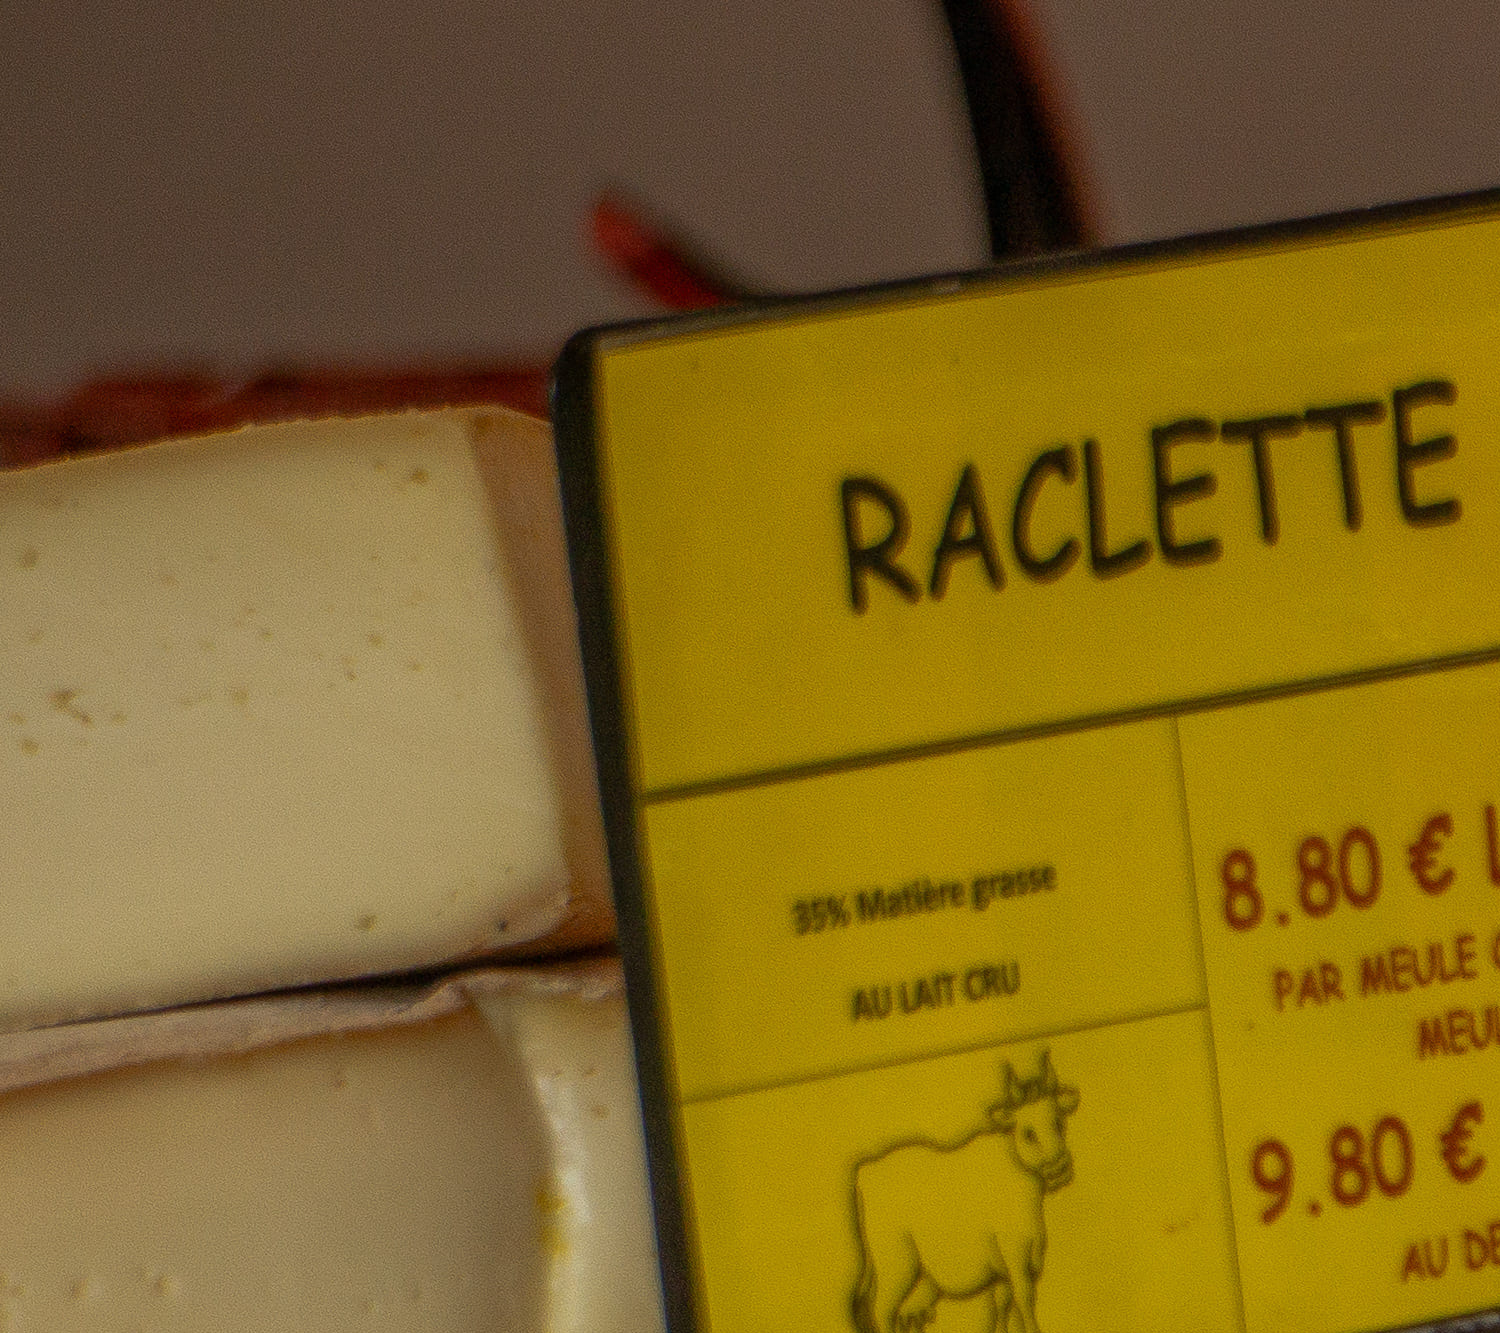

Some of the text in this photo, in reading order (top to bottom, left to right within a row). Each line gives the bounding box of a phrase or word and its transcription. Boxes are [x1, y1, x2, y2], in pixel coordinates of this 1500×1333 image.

[837, 377, 1462, 616] RACLETTE
[967, 864, 1057, 913] grasse
[1218, 824, 1383, 933] 8.80
[1406, 811, 1456, 897] €
[849, 962, 1021, 1022] AU LAIT CRU
[1271, 960, 1345, 1011] PAR
[1357, 932, 1478, 998] MEULE
[1249, 1114, 1415, 1225] 9.80
[1437, 1100, 1486, 1184] €
[1399, 1236, 1450, 1283] AU
